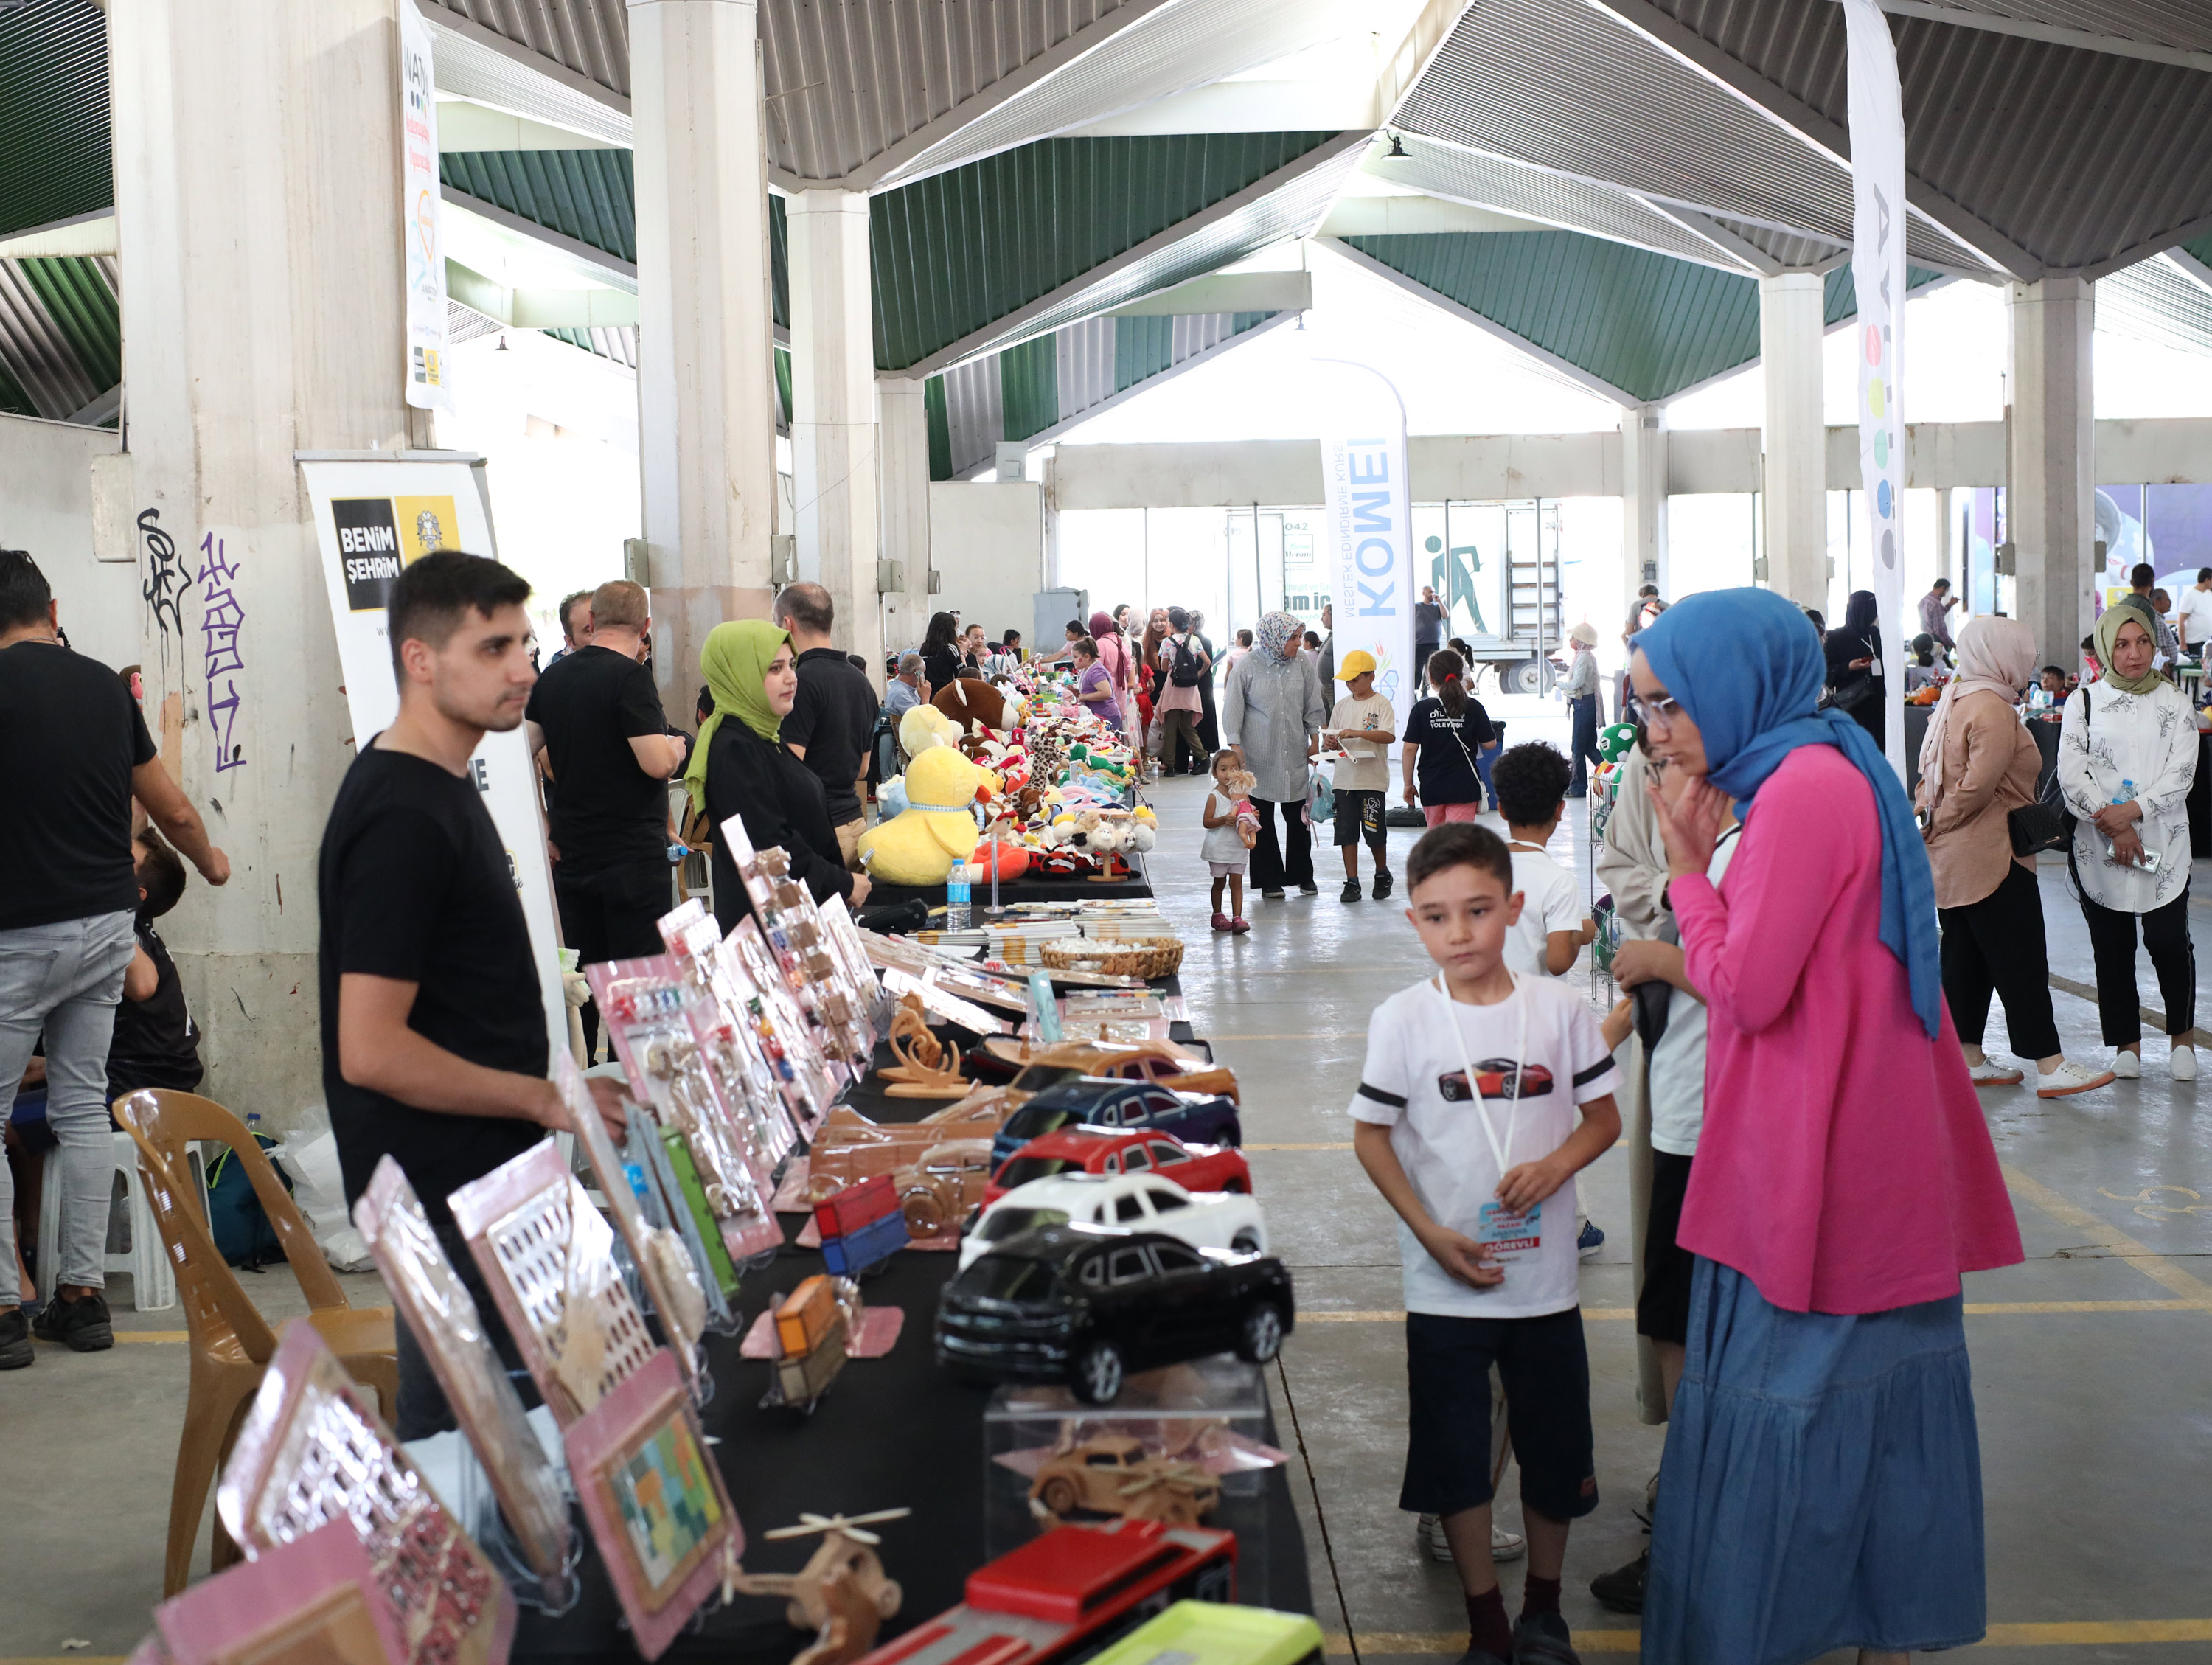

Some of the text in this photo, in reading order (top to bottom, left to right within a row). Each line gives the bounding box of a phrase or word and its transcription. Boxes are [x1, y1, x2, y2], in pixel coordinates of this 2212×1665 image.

[340, 526, 396, 553] BENİM
[346, 556, 400, 584] ŞEHRİM
[1487, 1238, 1534, 1251] GÖREVLİ
